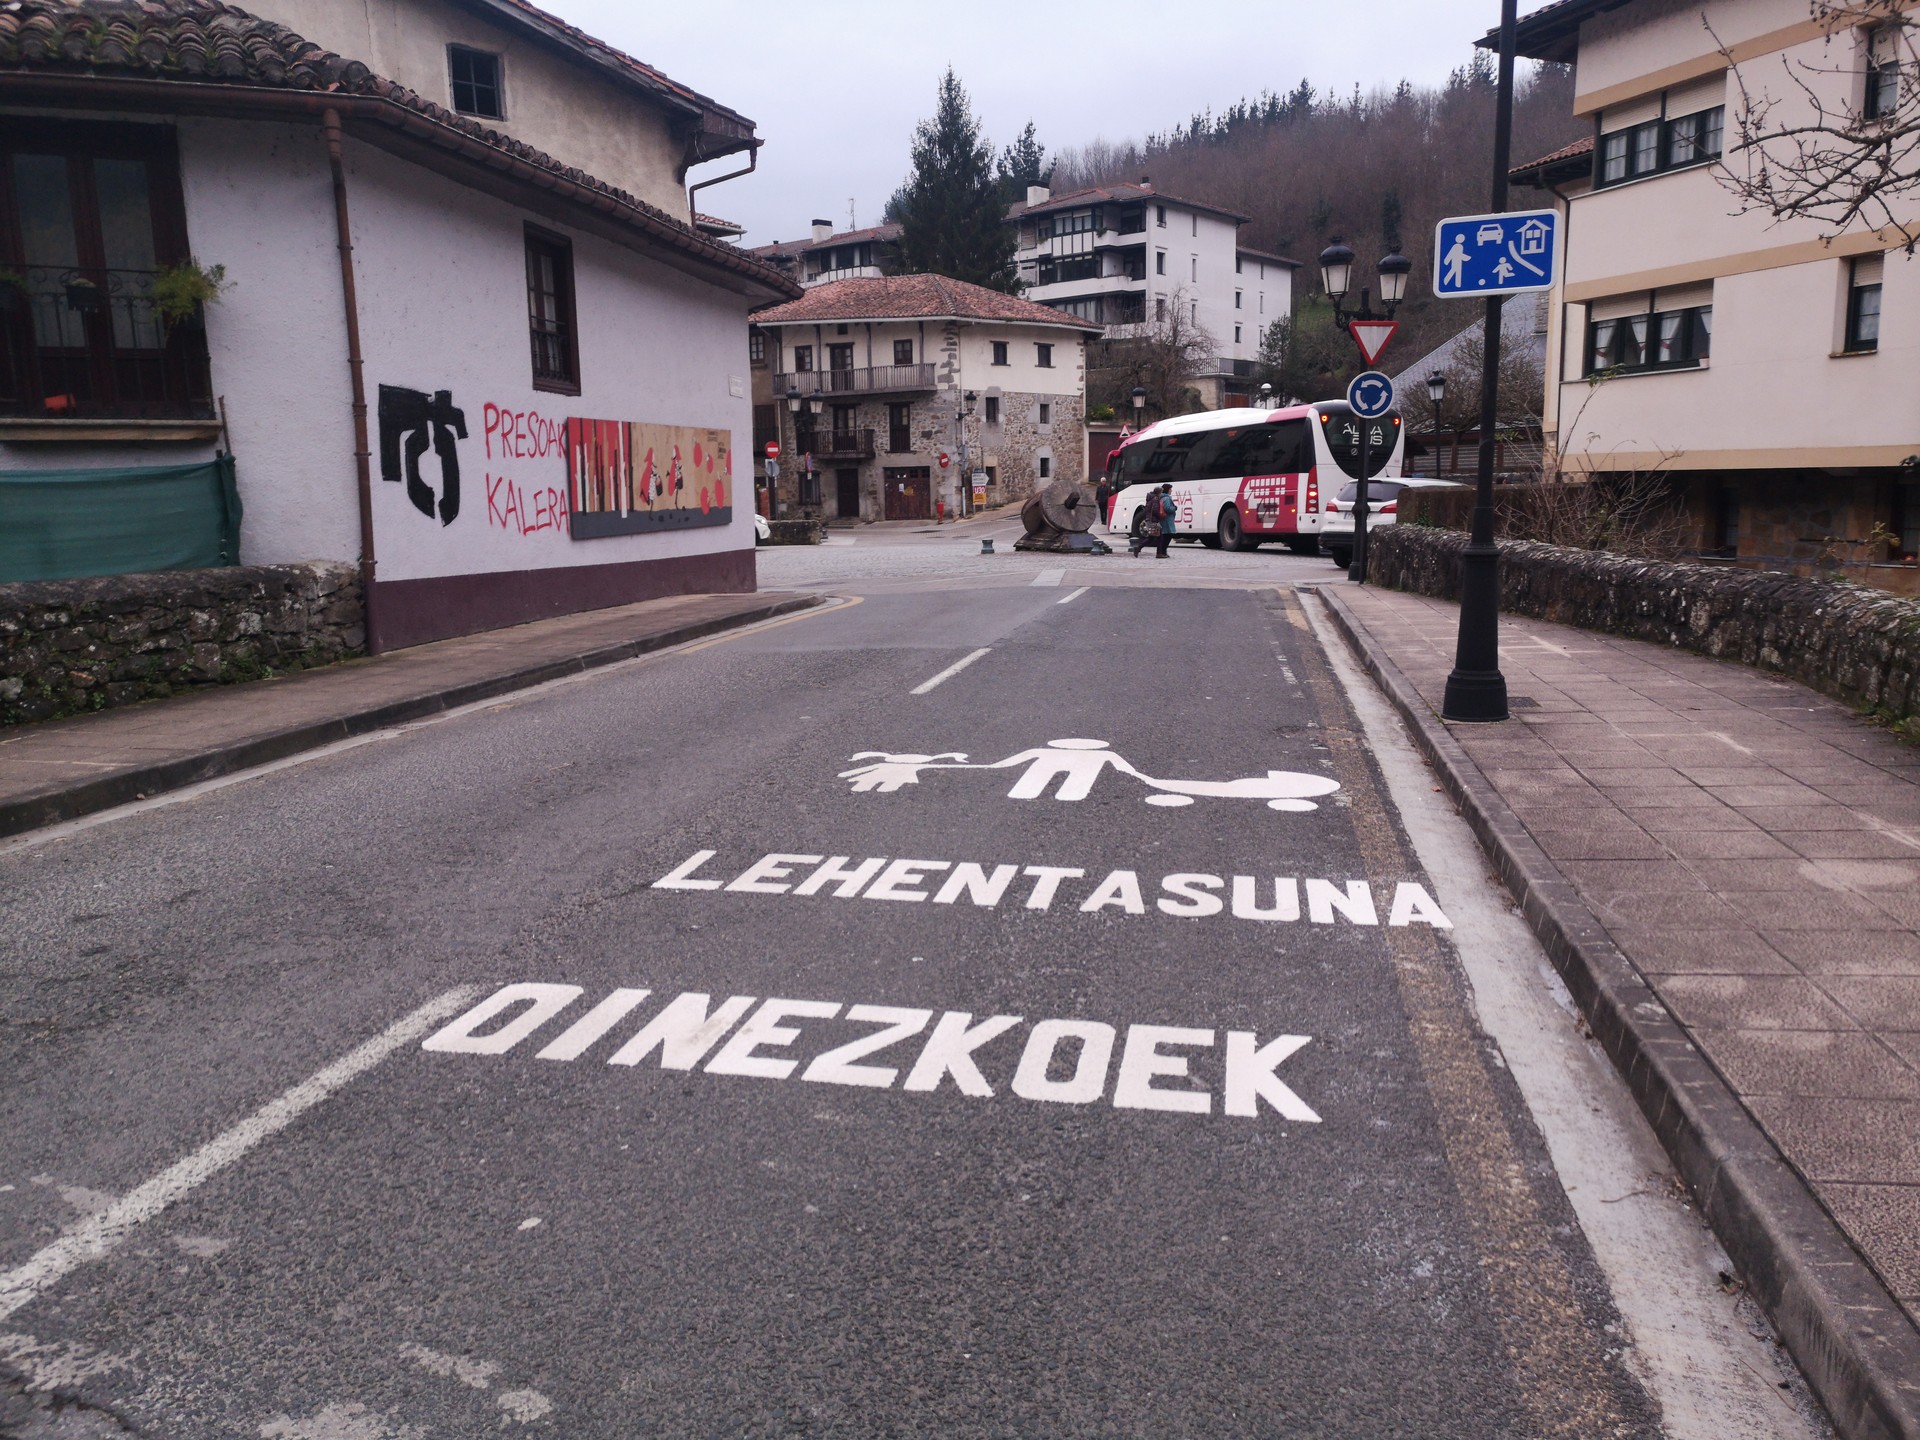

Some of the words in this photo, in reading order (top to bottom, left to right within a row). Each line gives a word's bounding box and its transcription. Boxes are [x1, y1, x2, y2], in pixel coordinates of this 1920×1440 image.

[483, 401, 568, 460] PRESOAK
[485, 472, 571, 537] KALERA
[651, 849, 1454, 929] LEHENTASUNA
